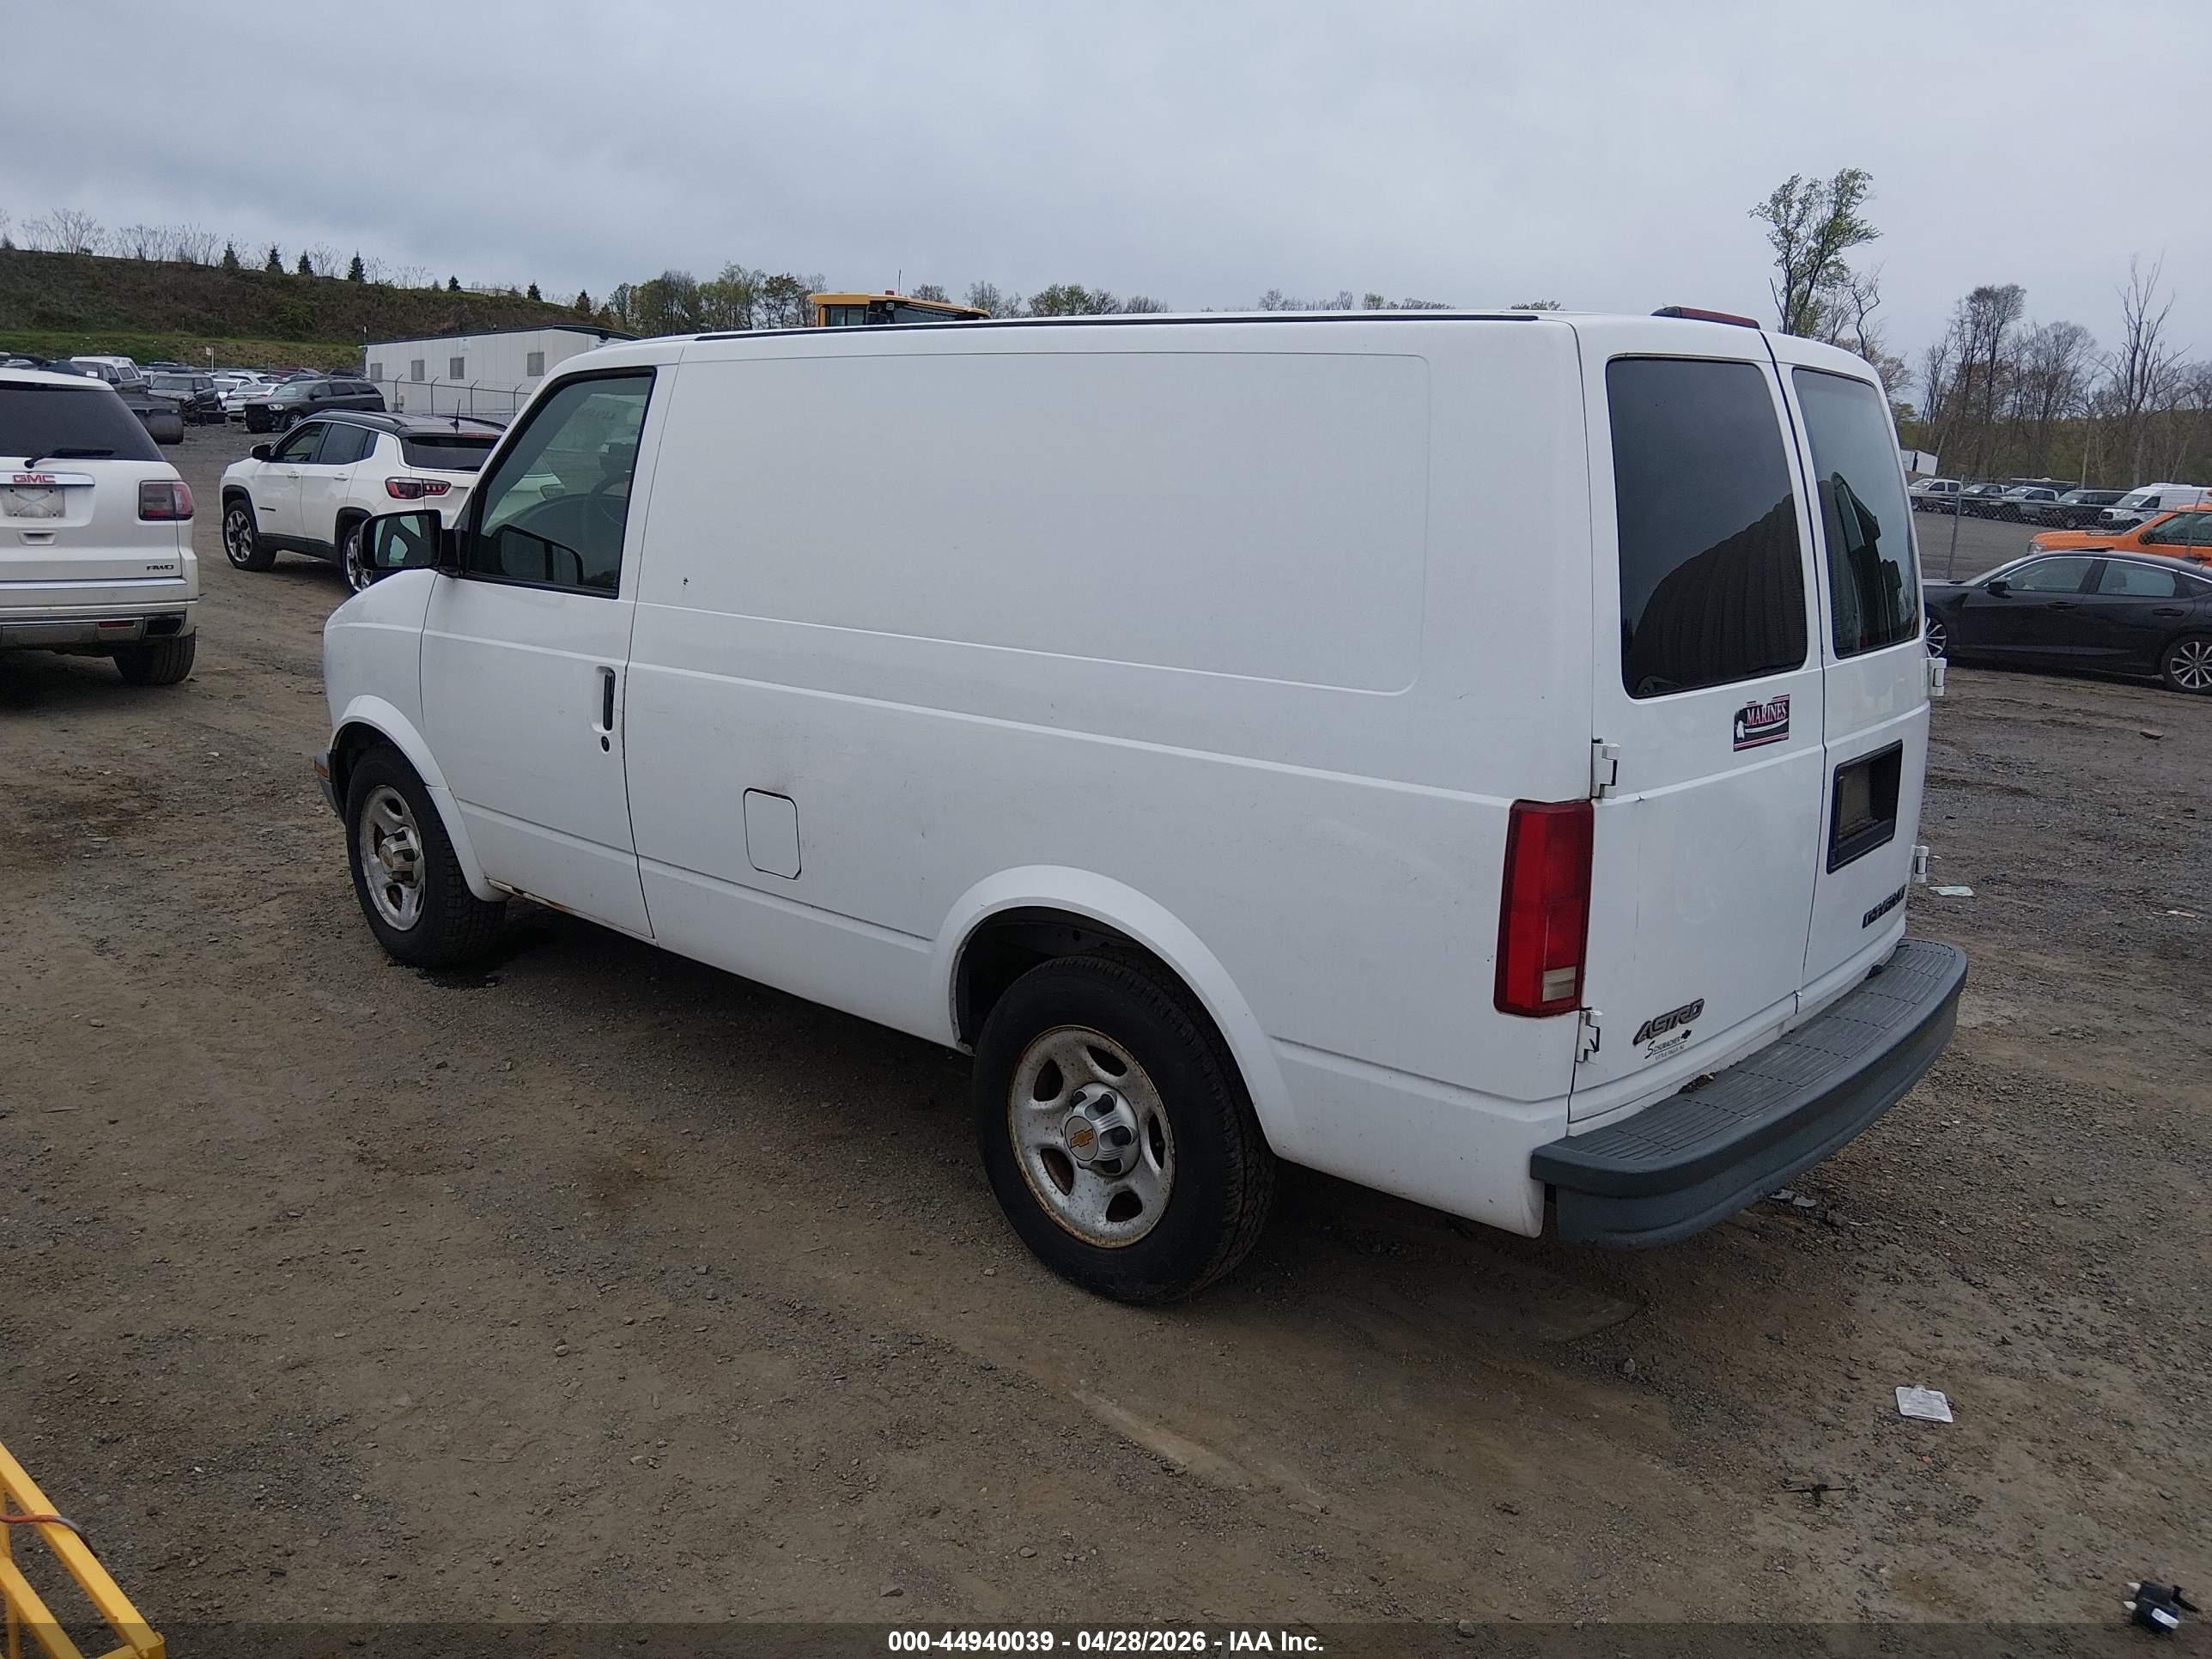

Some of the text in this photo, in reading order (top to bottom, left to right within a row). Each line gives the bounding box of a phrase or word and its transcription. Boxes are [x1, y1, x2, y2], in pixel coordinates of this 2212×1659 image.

[13, 475, 56, 484] GMC
[1747, 702, 1786, 726] MARINES
[1632, 998, 1705, 1046] ASTRO
